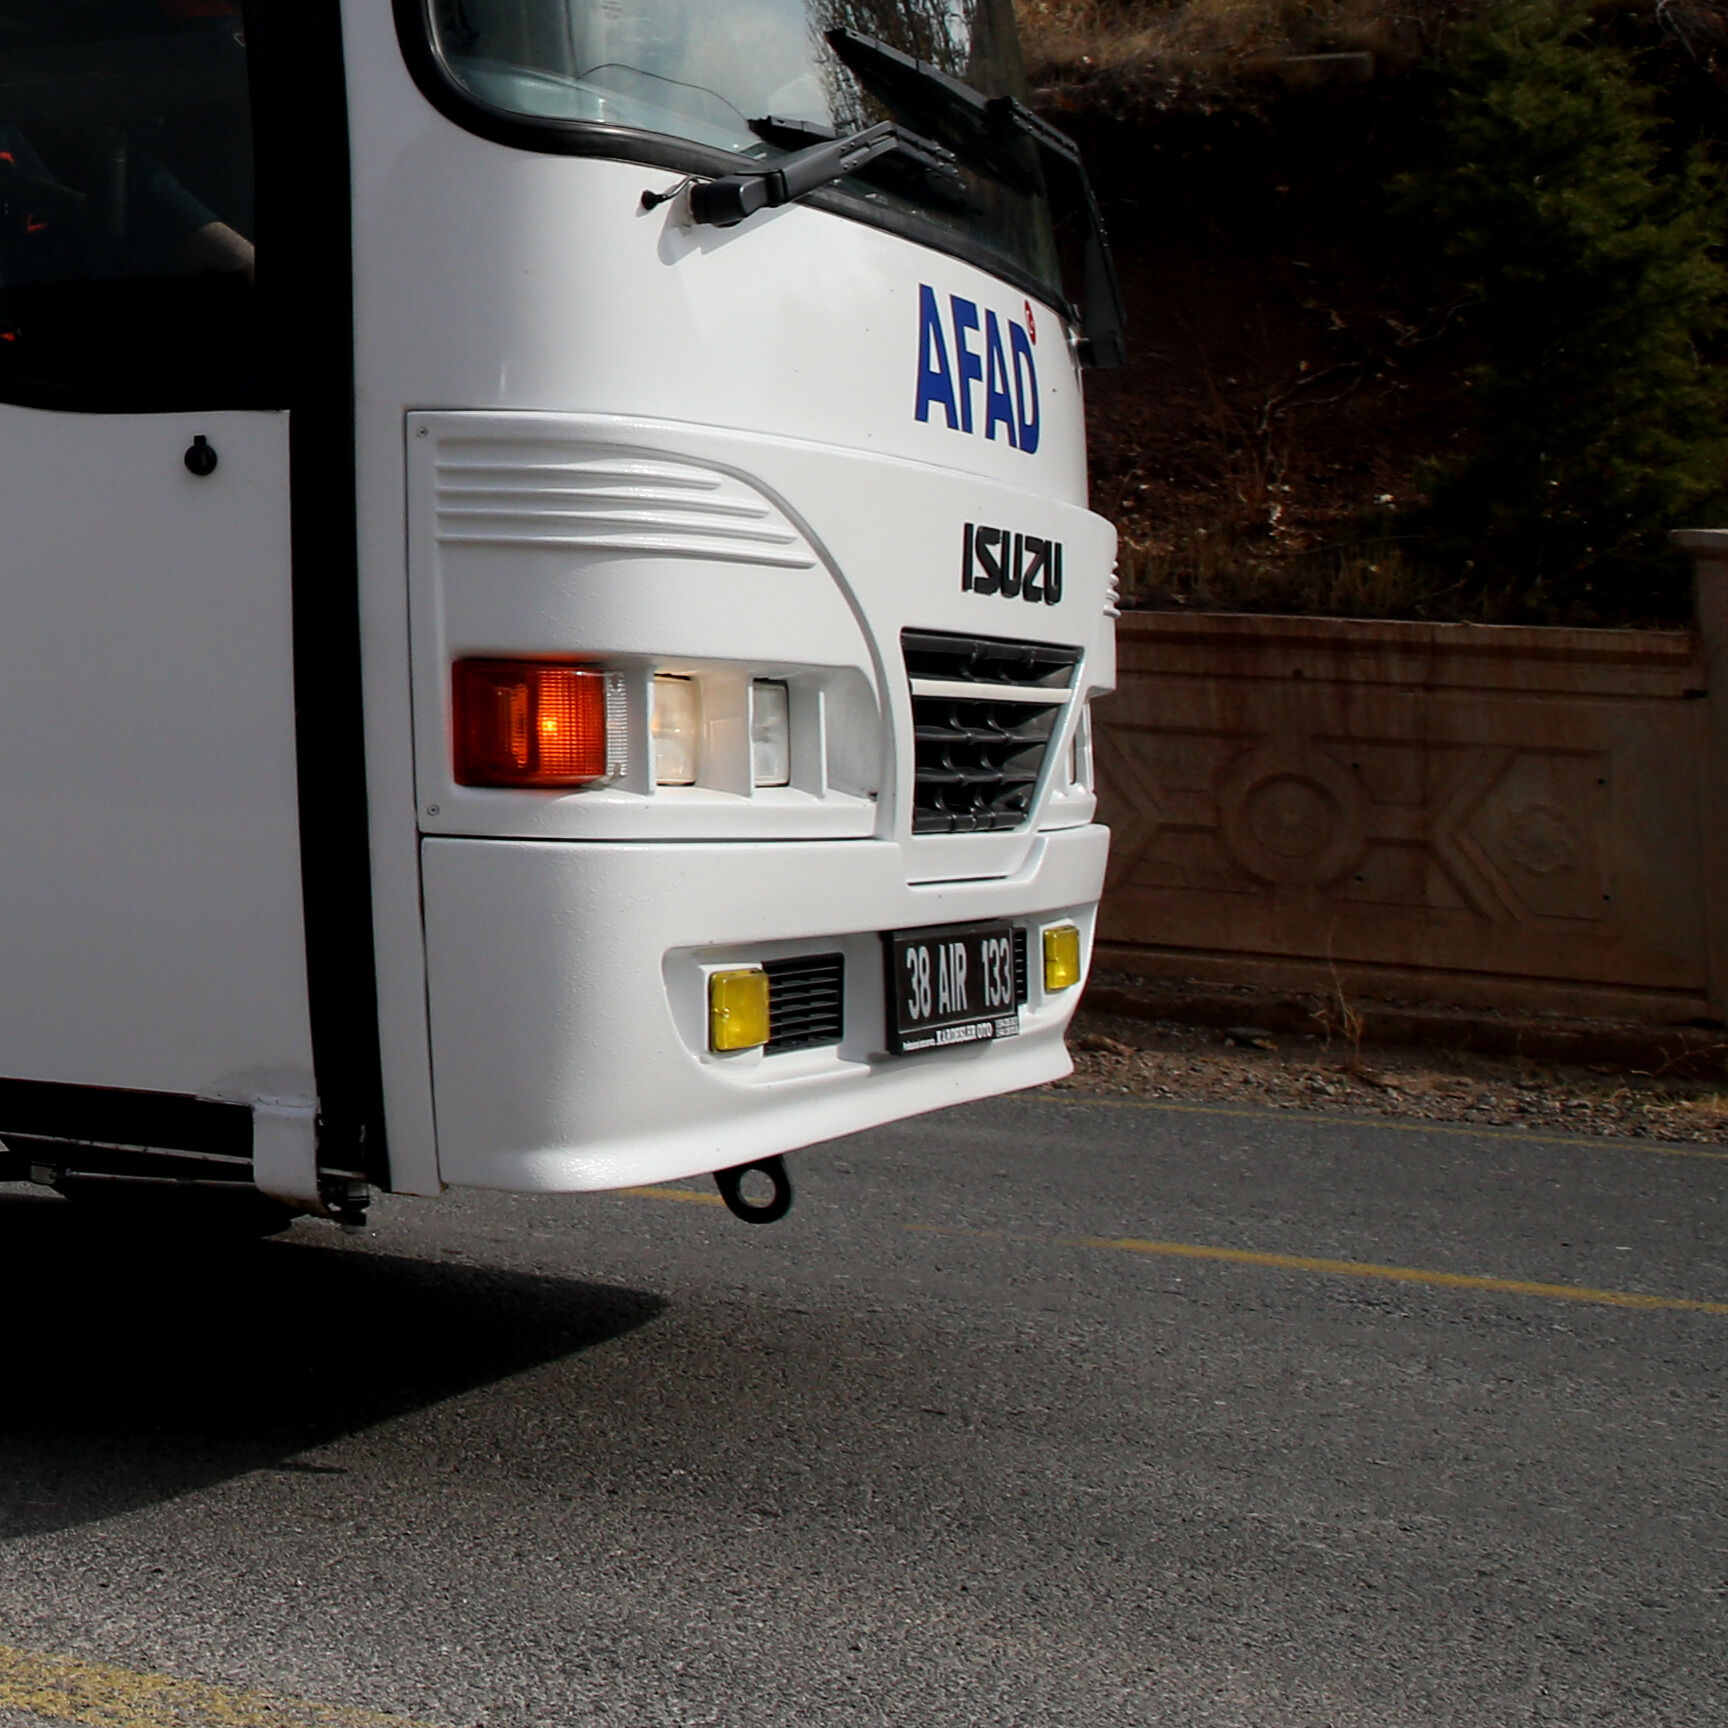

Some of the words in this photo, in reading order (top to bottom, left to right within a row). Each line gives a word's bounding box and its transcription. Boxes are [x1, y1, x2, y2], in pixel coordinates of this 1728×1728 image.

[914, 282, 1040, 455] AFAD
[961, 522, 1062, 606] ISUZU
[906, 945, 931, 1020] 38
[938, 942, 968, 1015] AIR
[981, 937, 1011, 1007] 133
